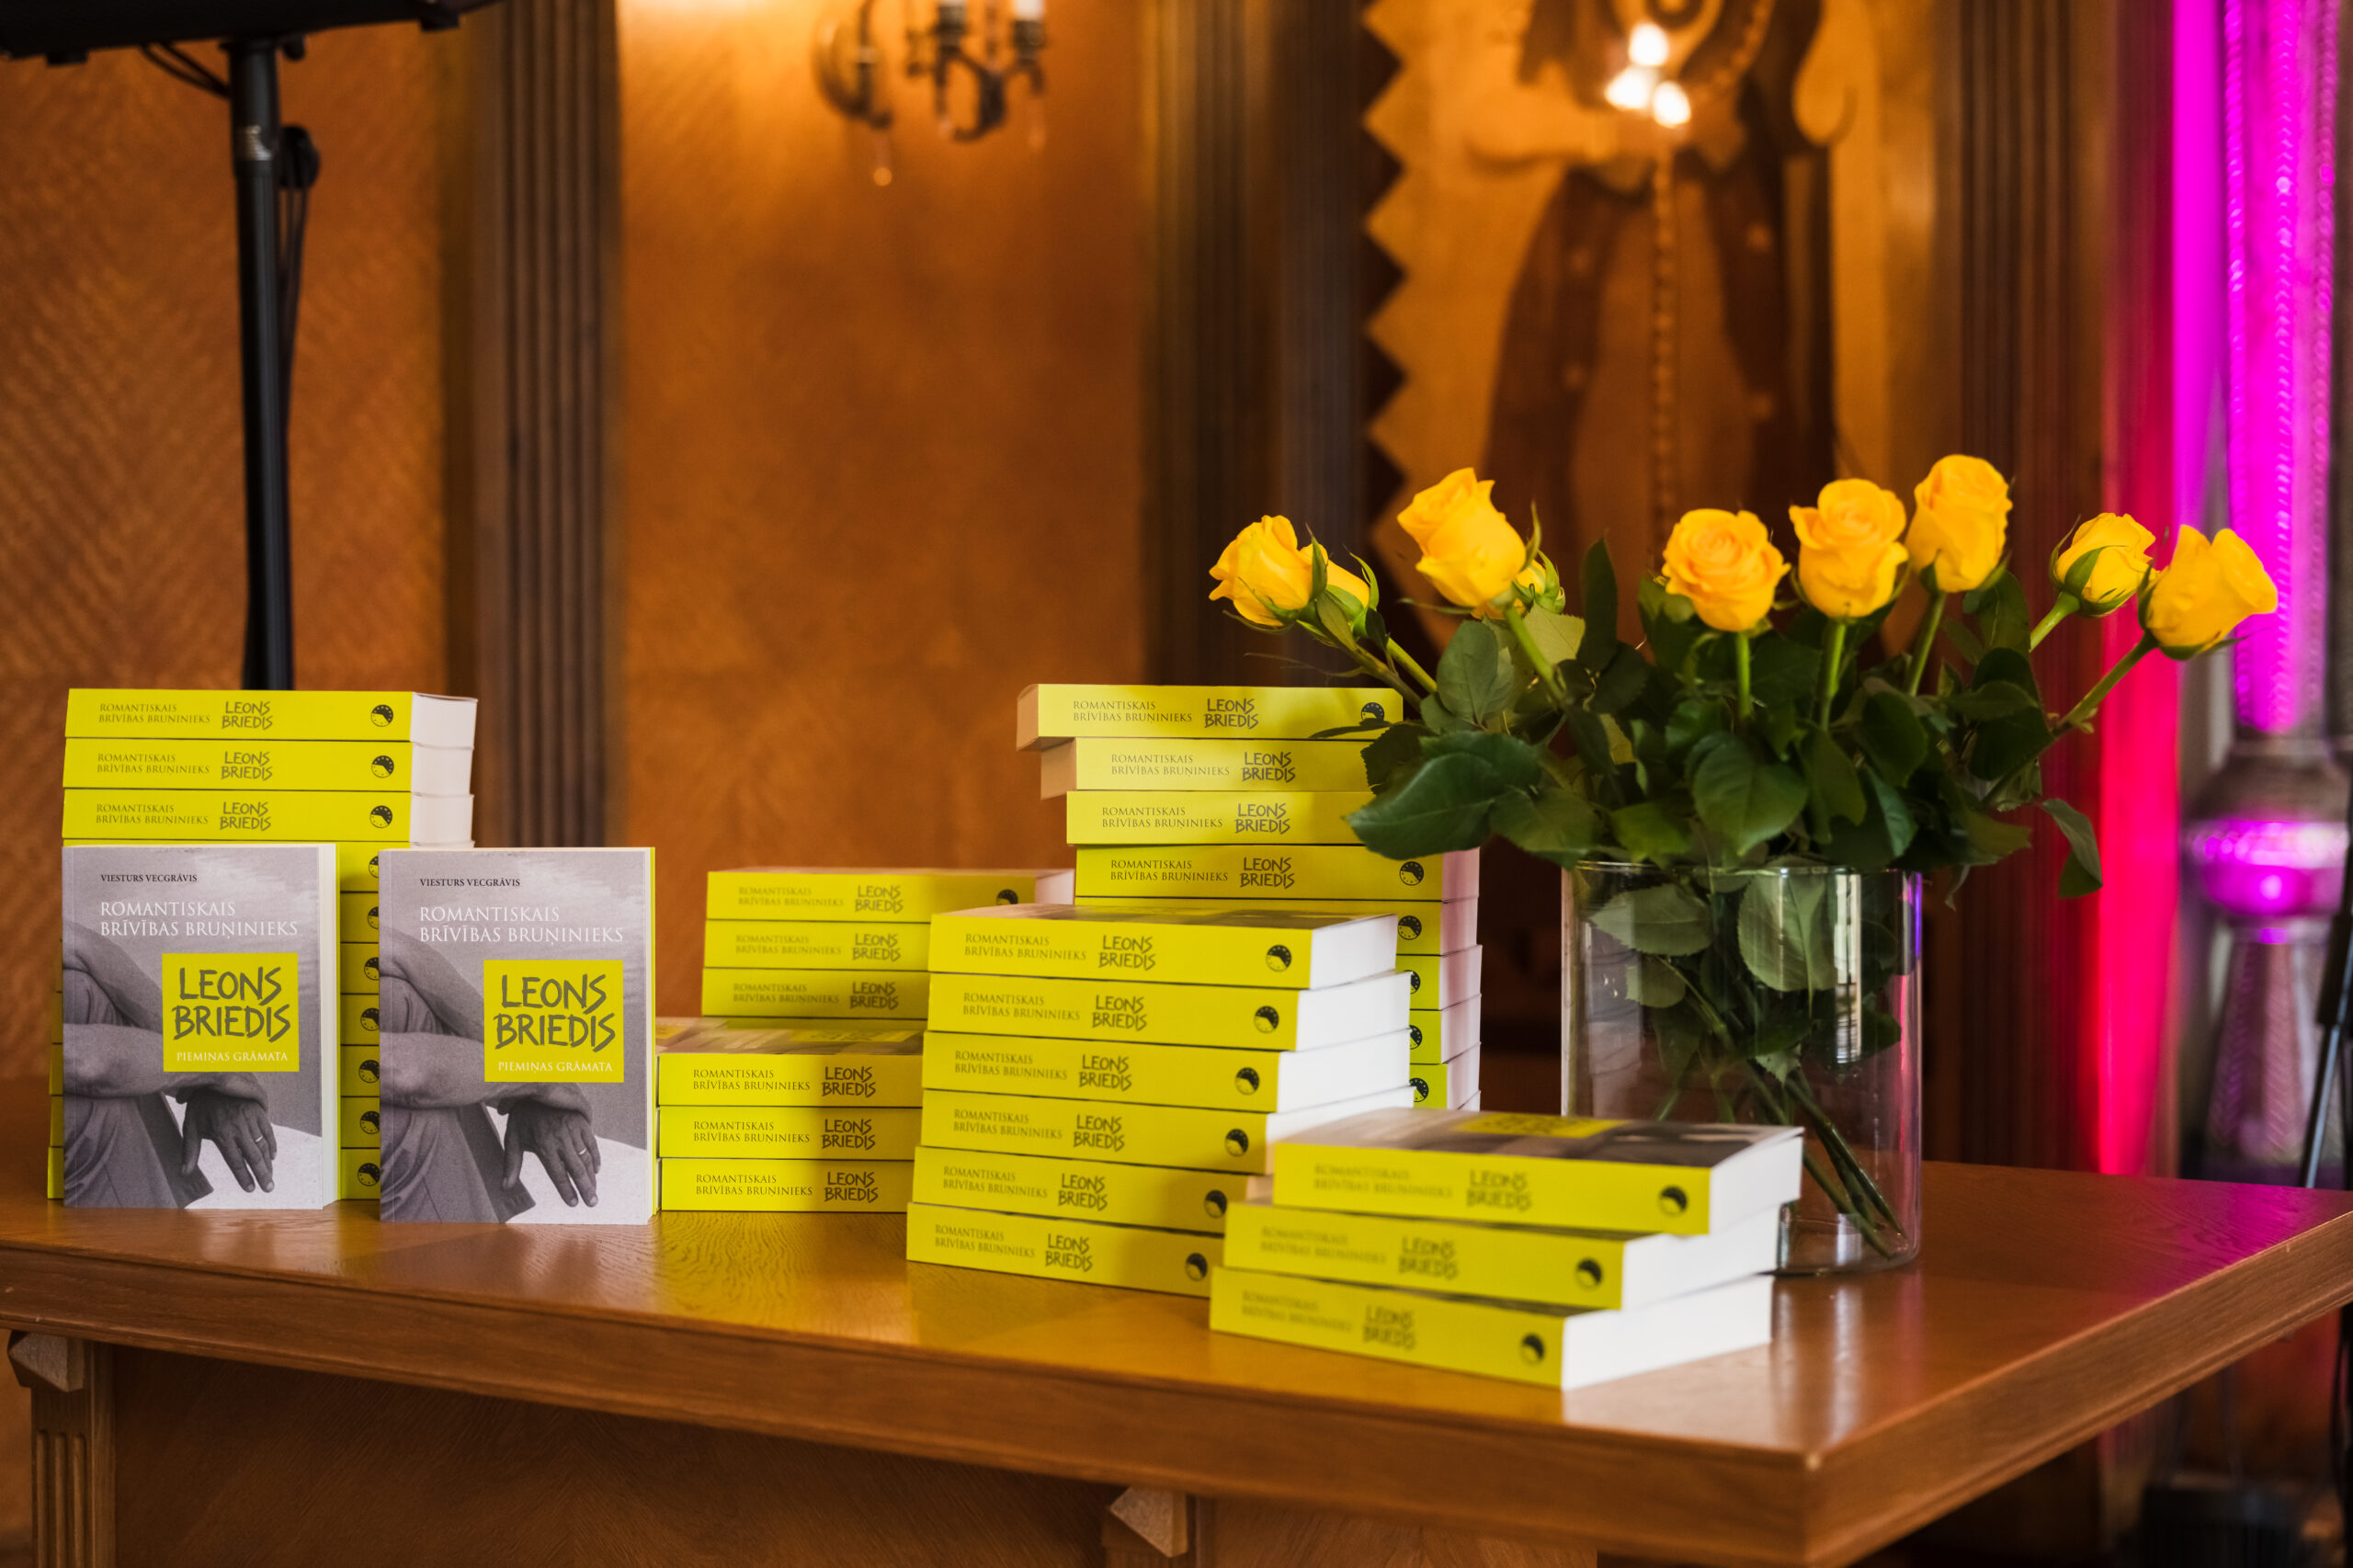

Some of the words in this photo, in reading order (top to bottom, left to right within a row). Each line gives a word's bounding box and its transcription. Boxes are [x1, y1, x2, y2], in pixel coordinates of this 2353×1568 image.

[99, 703, 176, 711] ROMANTISKAIS
[225, 701, 270, 715] LEONS
[1073, 700, 1155, 710] ROMANTISKAIS
[1207, 699, 1255, 714] LEONS
[222, 715, 272, 729] BRIEDIS
[1073, 711, 1120, 721] BRĪVĪBAS
[1125, 712, 1191, 722] BRUŅINIEKS
[1204, 713, 1258, 729] BRIEDIS
[97, 753, 176, 762] ROMANTISKAIS
[224, 751, 269, 766] LEONS
[1111, 754, 1193, 763] ROMANTISKAIS
[1245, 751, 1291, 767] LEONS
[221, 766, 272, 780] BRIEDIS
[1111, 765, 1158, 774] BRĪVĪBAS
[1163, 767, 1229, 777] BRUŅINIEKS
[1242, 767, 1295, 783] BRIEDIS
[97, 803, 174, 812] ROMANTISKAIS
[222, 801, 268, 816] LEONS
[1102, 807, 1185, 815] ROMANTISKAIS
[1237, 802, 1286, 819] LEONS
[219, 816, 270, 831] BRIEDIS
[1102, 817, 1150, 827] BRĪVĪBAS
[1154, 819, 1222, 829] BRUŅINIEKS
[1234, 819, 1290, 834] BRIEDIS
[1110, 859, 1191, 869] ROMANTISKAIS
[1243, 857, 1290, 873] LEONS
[100, 874, 143, 882] VIESTURS
[146, 873, 198, 881] VECGRĀVIS
[420, 879, 464, 887] VIESTURS
[467, 878, 520, 886] VECGRĀVIS
[1110, 870, 1157, 880] BRĪVĪBAS
[1162, 871, 1228, 882] BRUŅINIEKS
[1239, 873, 1294, 889] BRIEDIS
[858, 885, 901, 899] LEONS
[100, 902, 235, 916] ROMANTISKAIS
[855, 899, 903, 913] BRIEDIS
[420, 906, 560, 922] ROMANTISKAIS
[100, 920, 178, 937] BRĪVĪBAS
[186, 921, 298, 939] BRUŅINIEKS
[420, 926, 501, 941] BRĪVĪBAS
[508, 927, 623, 945] BRUŅINIEKS
[855, 934, 897, 948] LEONS
[966, 934, 1049, 945] ROMANTISKAIS
[1102, 936, 1153, 952] LEONS
[852, 948, 900, 961] BRIEDIS
[1098, 952, 1155, 970] BRIEDIS
[179, 967, 281, 1006] LEONS
[852, 982, 895, 995] LEONS
[501, 974, 607, 1015] LEONS
[849, 995, 898, 1009] BRIEDIS
[963, 993, 1044, 1005] ROMANTISKAIS
[1096, 995, 1143, 1013] LEONS
[172, 1005, 290, 1042] BRIEDIS
[1092, 1013, 1147, 1029] BRIEDIS
[493, 1013, 616, 1052] BRIEDIS
[176, 1051, 230, 1063] PIEMIŅAS
[233, 1051, 288, 1062] GRĀMATA
[955, 1051, 1033, 1063] ROMANTISKAIS
[1082, 1055, 1129, 1073] LEONS
[498, 1062, 553, 1074] PIEMIŅAS
[556, 1060, 612, 1072] GRĀMATA
[693, 1069, 774, 1078] ROMANTISKAIS
[824, 1066, 872, 1082] LEONS
[693, 1079, 740, 1089] BRĪVĪBAS
[744, 1081, 810, 1091] BRUŅINIEKS
[1078, 1072, 1131, 1090] BRIEDIS
[822, 1082, 875, 1097] BRIEDIS
[954, 1109, 1029, 1122] ROMANTISKAIS
[694, 1121, 774, 1130] ROMANTISKAIS
[824, 1119, 871, 1134] LEONS
[1076, 1115, 1122, 1133] LEONS
[693, 1131, 740, 1141] BRĪVĪBAS
[745, 1132, 810, 1143] BRUŅINIEKS
[821, 1134, 875, 1150] BRIEDIS
[1073, 1131, 1124, 1151] BRIEDIS
[696, 1175, 776, 1183] ROMANTISKAIS
[827, 1171, 874, 1187] LEONS
[1062, 1174, 1105, 1193] LEONS
[696, 1185, 742, 1194] BRĪVĪBAS
[746, 1186, 812, 1197] BRUŅINIEKS
[824, 1187, 878, 1202] BRIEDIS
[1058, 1191, 1108, 1210] BRIEDIS
[1047, 1233, 1089, 1254] LEONS
[1045, 1251, 1093, 1271] BRIEDIS
